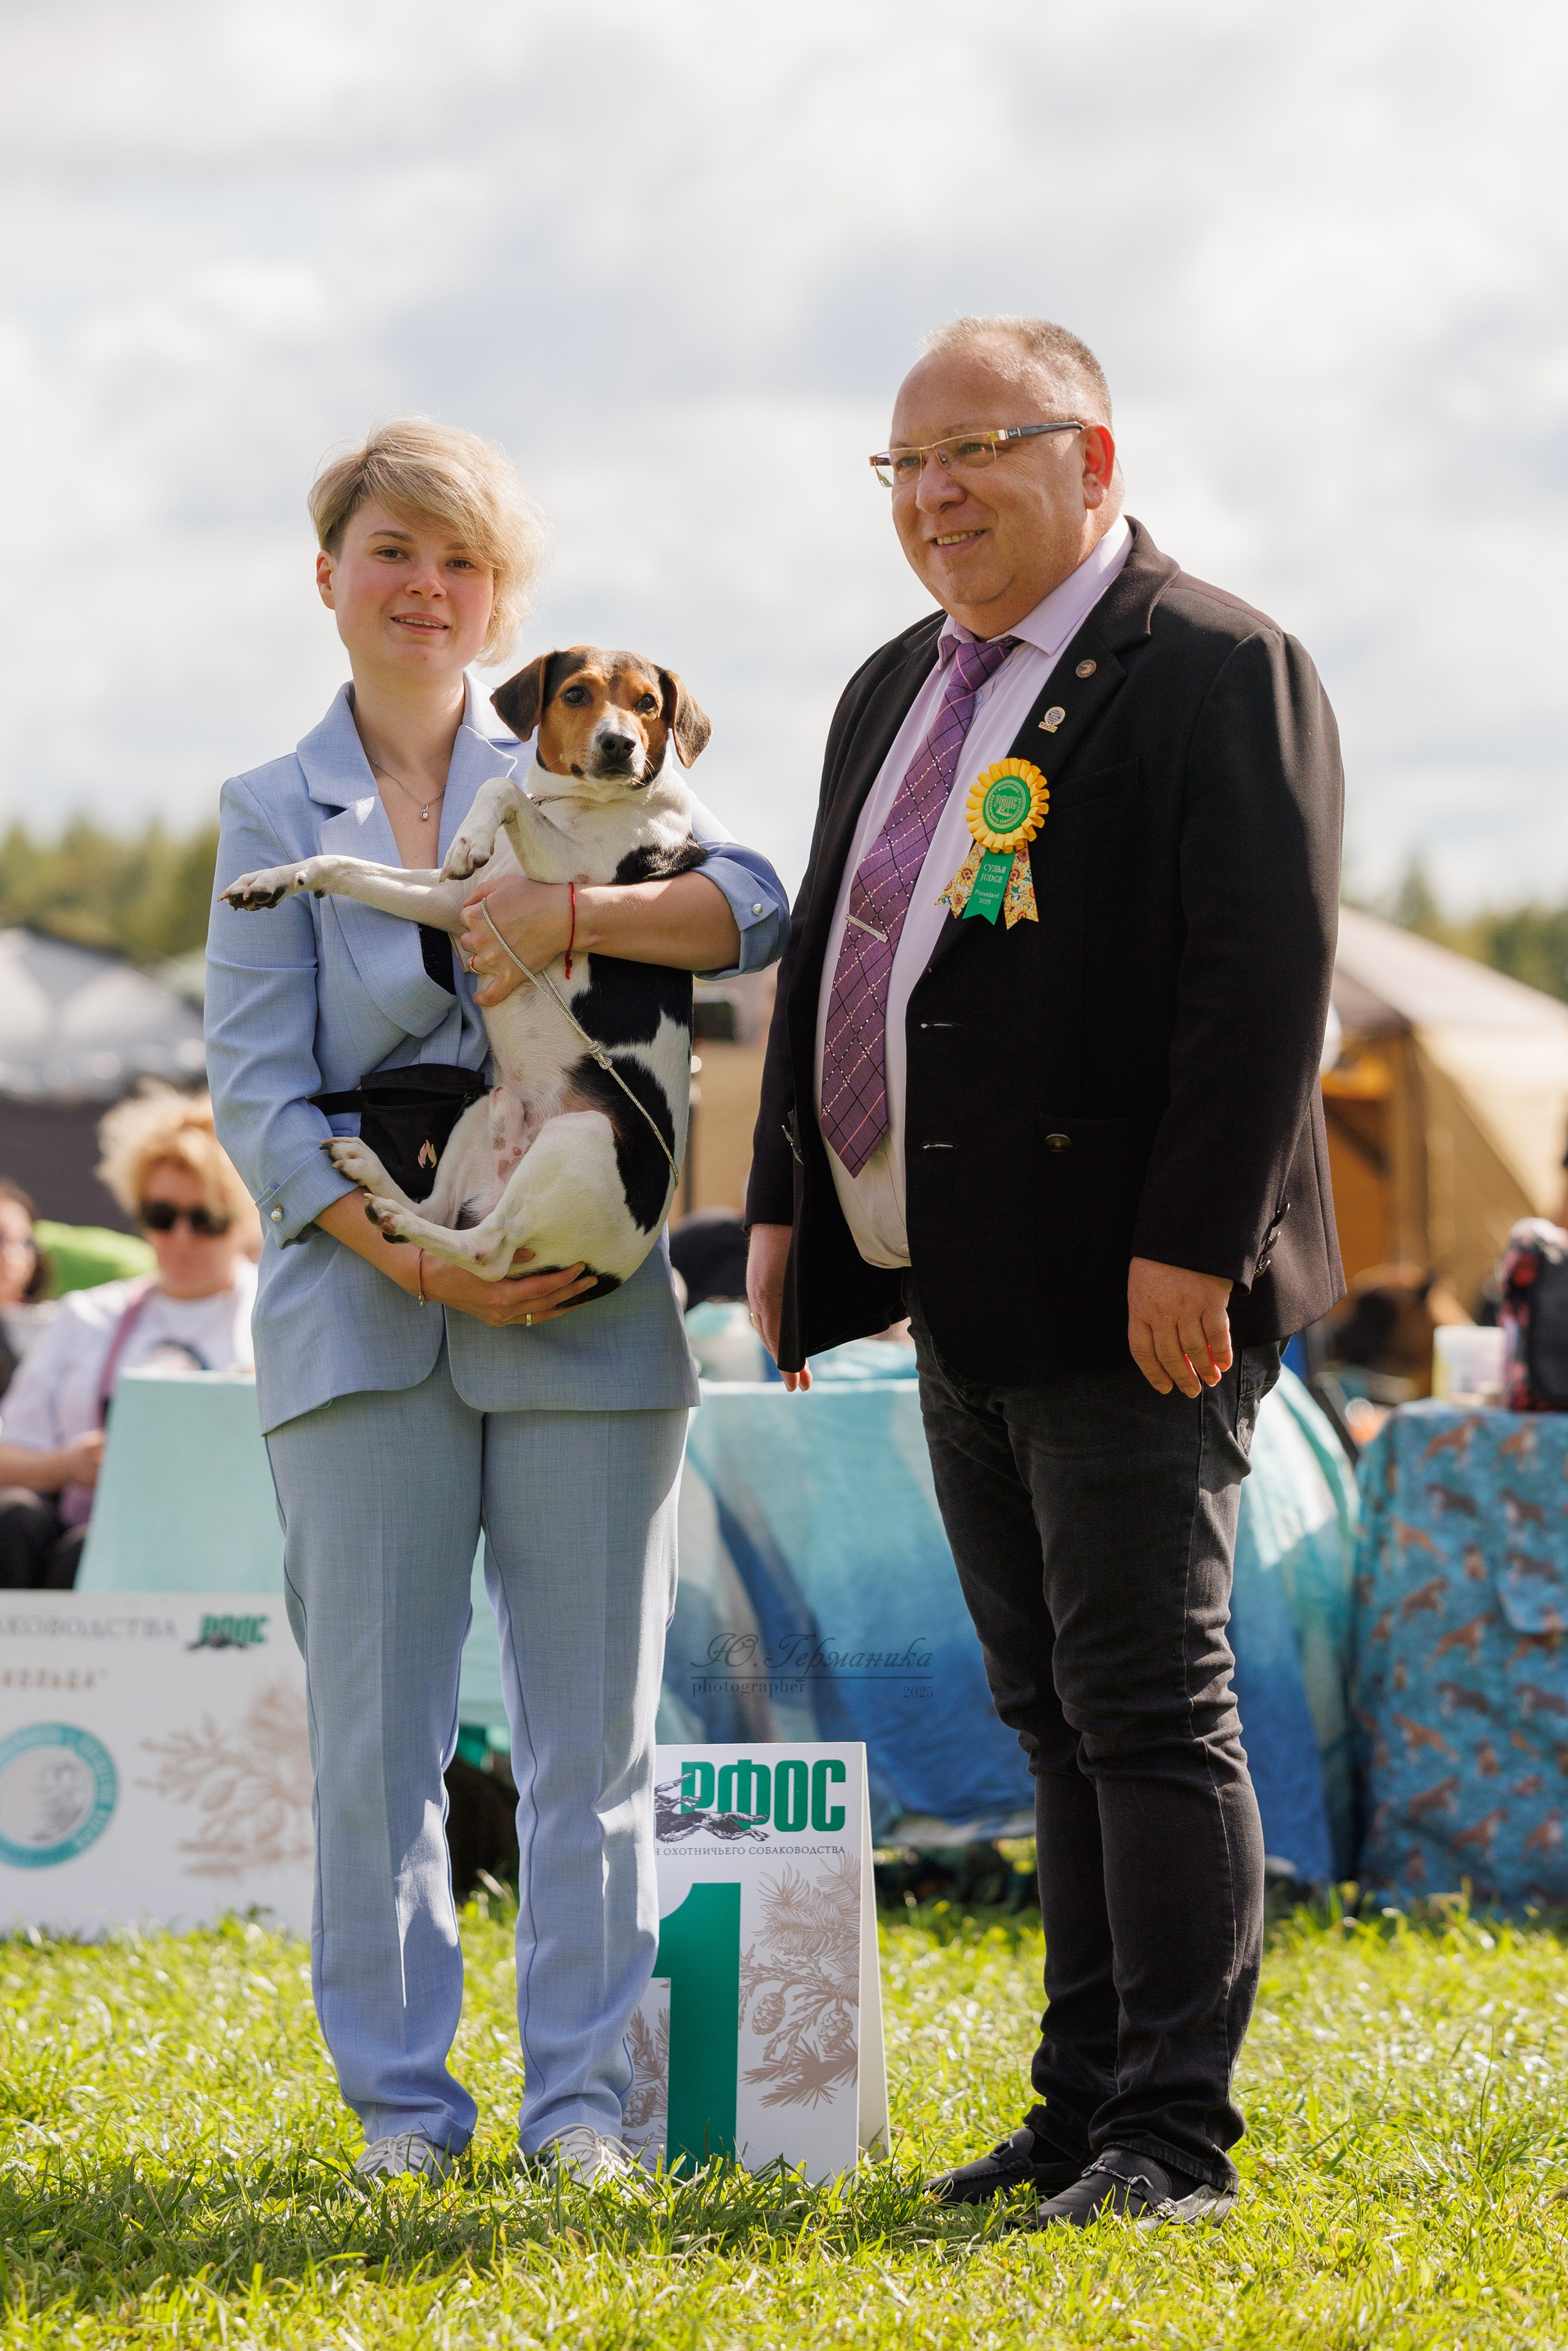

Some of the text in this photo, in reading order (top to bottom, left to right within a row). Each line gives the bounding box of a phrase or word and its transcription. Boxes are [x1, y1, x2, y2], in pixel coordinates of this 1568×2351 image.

[983, 864, 1006, 874] СУДЬЯ
[979, 873, 1003, 883] JUDGE
[974, 889, 1000, 899] Pereslavl
[681, 1759, 846, 1832] РФОС
[663, 1847, 745, 1855] ОХОТНИЧЬЕГО
[748, 1846, 845, 1855] СОБАКОВОДСТВА
[651, 1882, 741, 2175] 1
